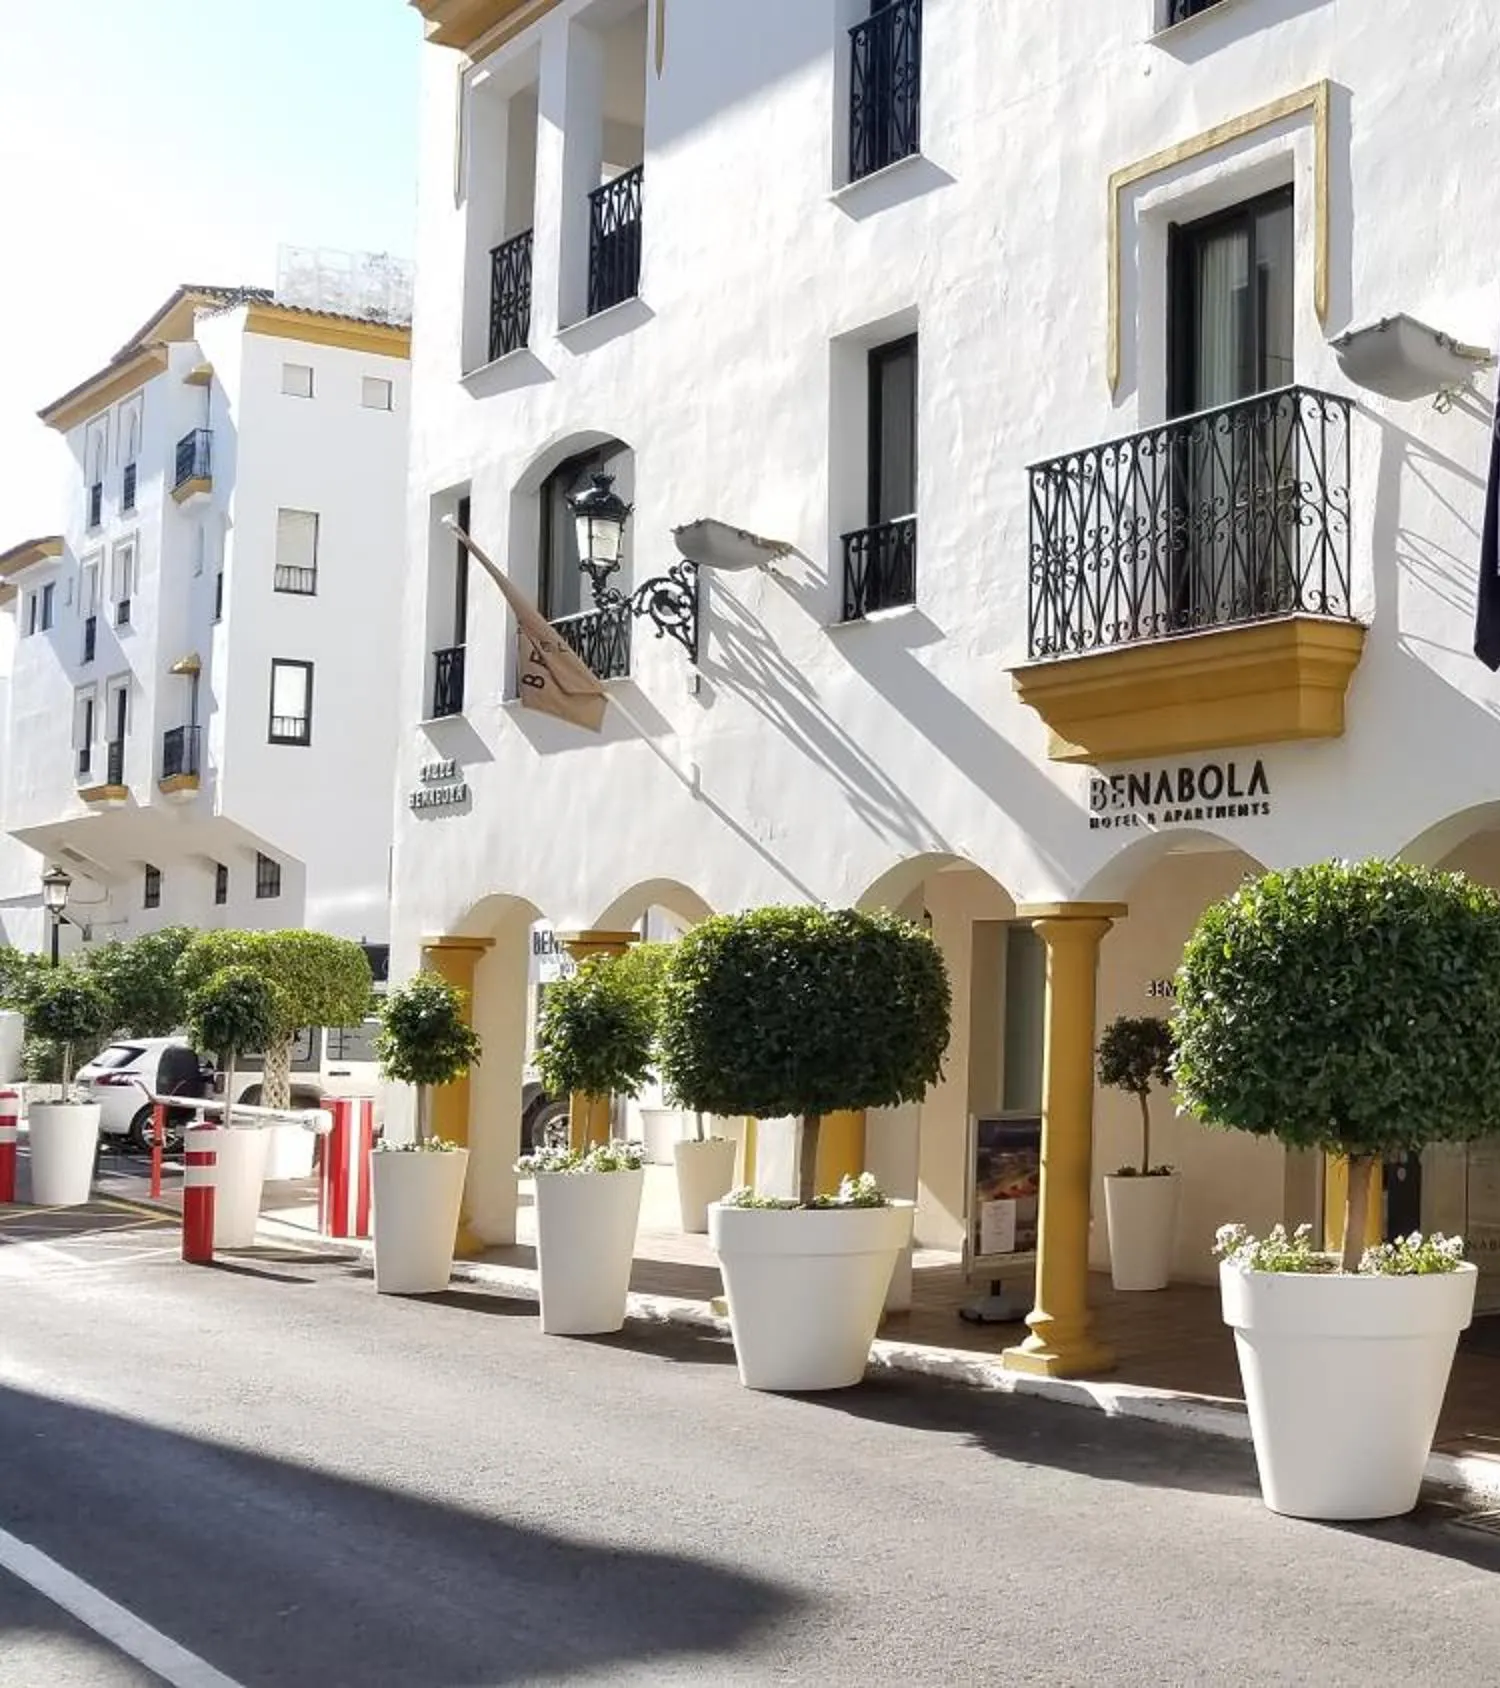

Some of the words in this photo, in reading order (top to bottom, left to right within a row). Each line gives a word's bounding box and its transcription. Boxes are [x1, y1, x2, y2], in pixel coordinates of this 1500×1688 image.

[1090, 760, 1270, 812] BENABOLA
[1090, 812, 1139, 829] HOTEL
[1164, 801, 1270, 823] APARTMENTS
[1144, 979, 1178, 997] BEN
